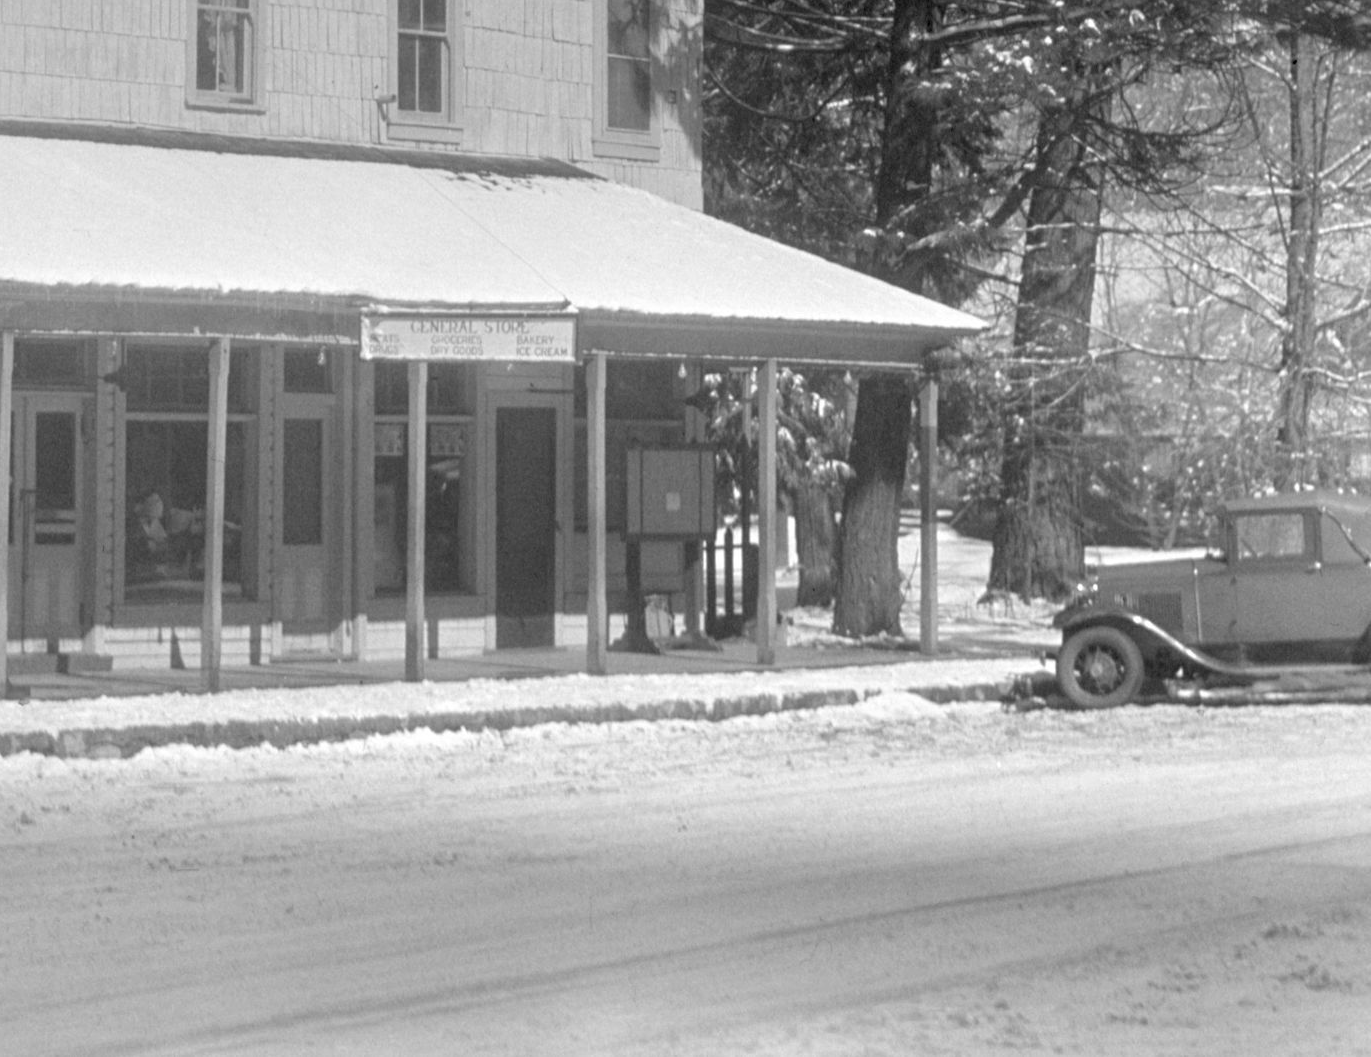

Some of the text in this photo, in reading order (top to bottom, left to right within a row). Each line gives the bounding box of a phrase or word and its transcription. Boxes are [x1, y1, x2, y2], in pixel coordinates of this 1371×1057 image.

[410, 320, 530, 334] GENERAL STORE
[431, 334, 482, 345] GROCERIES
[516, 335, 554, 345] BAKERY
[369, 344, 399, 355] DRUGS
[430, 345, 483, 356] DRY GOODS
[516, 346, 568, 357] ICE CREAM
